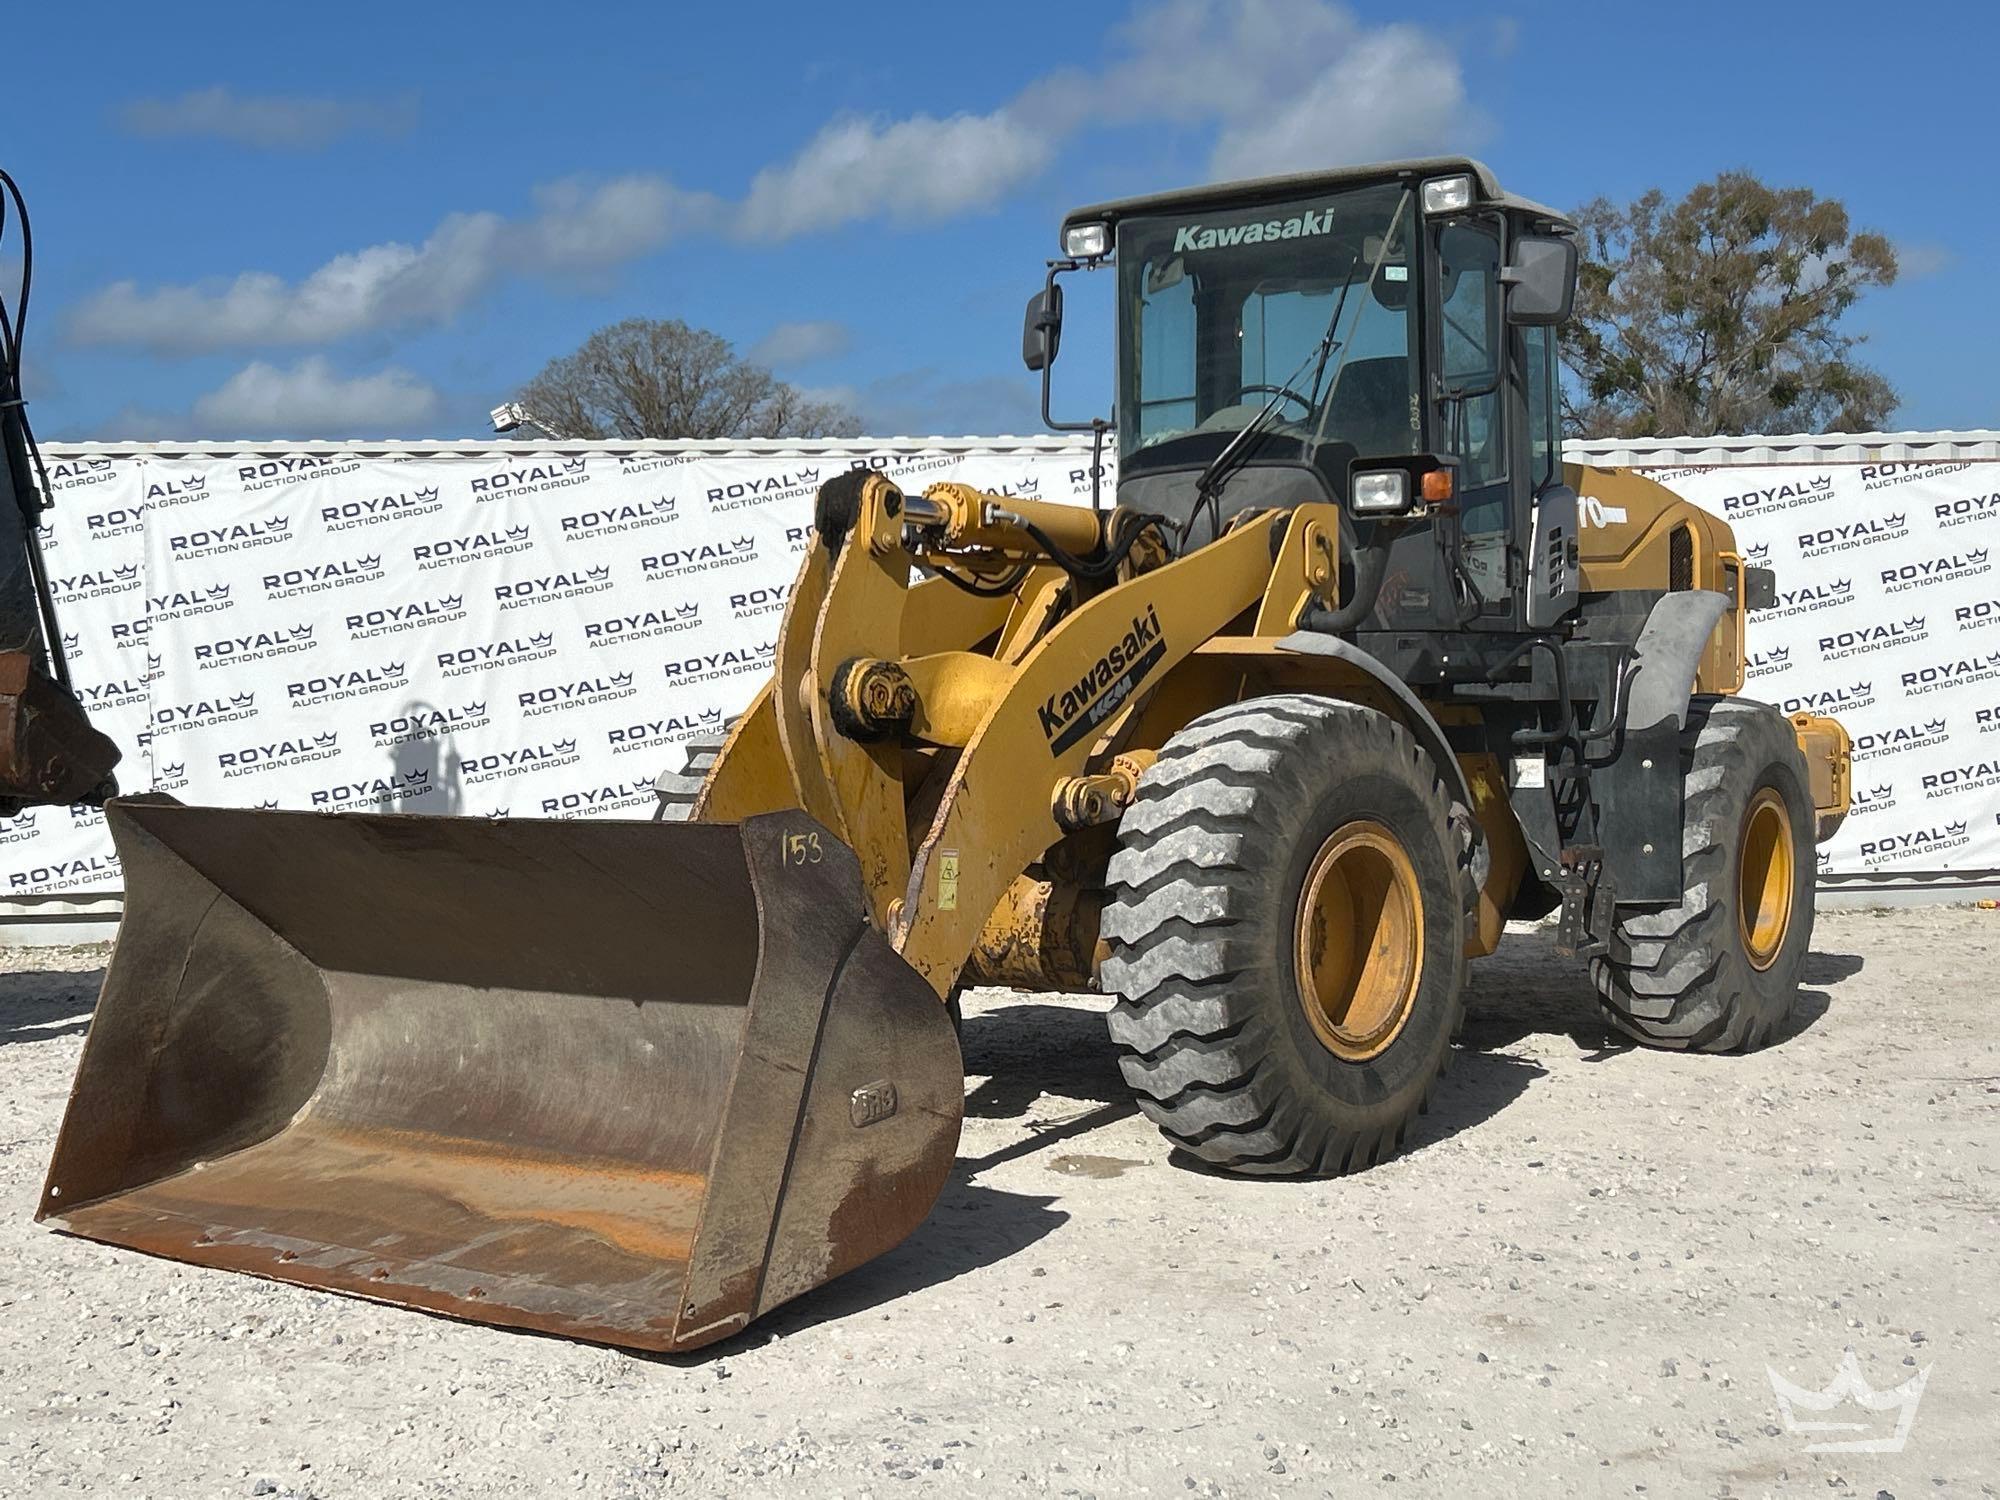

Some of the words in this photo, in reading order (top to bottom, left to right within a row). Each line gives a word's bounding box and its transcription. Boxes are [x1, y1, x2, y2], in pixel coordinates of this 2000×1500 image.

[1173, 208, 1335, 253] Kawasaki
[66, 472, 117, 489] GROUP
[244, 474, 307, 492] AUCTION
[310, 463, 360, 479] GROUP
[471, 465, 563, 493] ROYAL
[476, 485, 538, 503] AUCTION
[541, 475, 590, 491] GROUP
[707, 474, 797, 503] ROYAL
[1865, 472, 1922, 491] AUCTION
[159, 492, 210, 508] GROUP
[321, 494, 416, 522] ROYAL
[712, 495, 772, 513] AUCTION
[1723, 482, 1811, 511] ROYAL
[1728, 502, 1786, 520] AUCTION
[1789, 492, 1834, 508] GROUP
[1934, 493, 2000, 518] ROYA
[87, 505, 144, 530] ROY
[327, 514, 390, 533] AUCTION
[393, 504, 443, 519] GROUP
[561, 503, 653, 531] ROYAL
[566, 523, 628, 542] AUCTION
[631, 513, 679, 529] GROUP
[1939, 509, 1997, 528] AUCTION
[91, 523, 144, 540] AUCTIO
[170, 523, 265, 551] ROYAL
[1798, 520, 1884, 548] ROYAL
[1802, 540, 1860, 559] AUCTION
[1863, 529, 1909, 545] GROUP
[175, 543, 239, 561] AUCTION
[242, 533, 293, 548] GROUP
[413, 532, 506, 560] ROYAL
[418, 552, 481, 571] AUCTION
[484, 542, 533, 558] GROUP
[641, 543, 732, 571] ROYAL
[263, 561, 358, 590] ROYAL
[646, 563, 707, 582] AUCTION
[710, 553, 758, 569] GROUP
[1881, 556, 1967, 584] ROYAL
[1885, 575, 1943, 594] AUCTION
[1946, 565, 1991, 581] GROUP
[53, 591, 93, 605] TION
[91, 581, 142, 598] GROUP
[268, 582, 332, 600] AUCTION
[335, 571, 385, 587] GROUP
[494, 572, 587, 600] ROYAL
[500, 592, 562, 611] AUCTION
[565, 582, 613, 598] GROUP
[730, 584, 795, 609] ROY
[147, 611, 180, 625] TION
[183, 600, 234, 617] GROUP
[346, 601, 440, 630] ROYAL
[734, 602, 788, 620] AUCTIO
[1748, 605, 1806, 624] AUCTION
[1809, 595, 1855, 611] GROUP
[351, 621, 414, 640] AUCTION
[417, 611, 467, 627] GROUP
[585, 610, 676, 638] ROYAL
[590, 630, 651, 648] AUCTION
[654, 619, 702, 635] GROUP
[1818, 623, 1904, 652] ROYAL
[1959, 616, 2000, 632] AUCTI
[194, 631, 290, 660] ROYAL
[200, 651, 264, 670] AUCTION
[266, 641, 317, 657] GROUP
[437, 639, 530, 668] ROYAL
[1823, 643, 1880, 661] AUCTION
[1883, 632, 1928, 648] GROUP
[442, 659, 505, 678] AUCTION
[507, 649, 557, 665] GROUP
[664, 649, 755, 677] ROYAL
[1037, 603, 1161, 740] Kawasaki
[1747, 662, 1793, 679] GROUP
[1901, 658, 1987, 687] ROYAL
[287, 669, 382, 698] ROYAL
[669, 669, 730, 687] AUCTION
[1906, 678, 1963, 697] AUCTION
[1966, 669, 2000, 683] GROU
[292, 690, 356, 708] AUCTION
[358, 679, 409, 695] GROUP
[518, 678, 610, 707] ROYAL
[523, 698, 585, 717] AUCTION
[588, 688, 637, 704] GROUP
[1830, 697, 1875, 714] GROUP
[150, 699, 230, 726] OYAL
[151, 719, 205, 737] UCTION
[208, 709, 259, 726] GROUP
[369, 708, 463, 737] ROYAL
[374, 729, 437, 748] AUCTION
[440, 718, 490, 734] GROUP
[608, 716, 699, 744] ROYAL
[218, 739, 314, 768] ROYAL
[613, 735, 674, 754] AUCTION
[1852, 745, 1901, 762] UCTION
[1903, 734, 1950, 750] GROUP
[224, 759, 287, 778] AUCTION
[290, 748, 341, 765] GROUP
[461, 745, 553, 774] ROYAL
[466, 765, 528, 785] AUCTION
[531, 755, 580, 771] GROUP
[311, 776, 405, 805] ROYAL
[383, 785, 432, 802] GROUP
[542, 784, 633, 813] ROYAL
[1926, 780, 1984, 799] AUCTION
[548, 804, 608, 820] UCTION
[1850, 800, 1896, 816] GROUP
[782, 828, 823, 868] 153
[1860, 827, 1946, 857] ROYAL
[1864, 847, 1922, 867] AUCTION
[1924, 836, 1970, 853] GROUP
[9, 857, 105, 887] ROYAL
[82, 869, 123, 884] GROU
